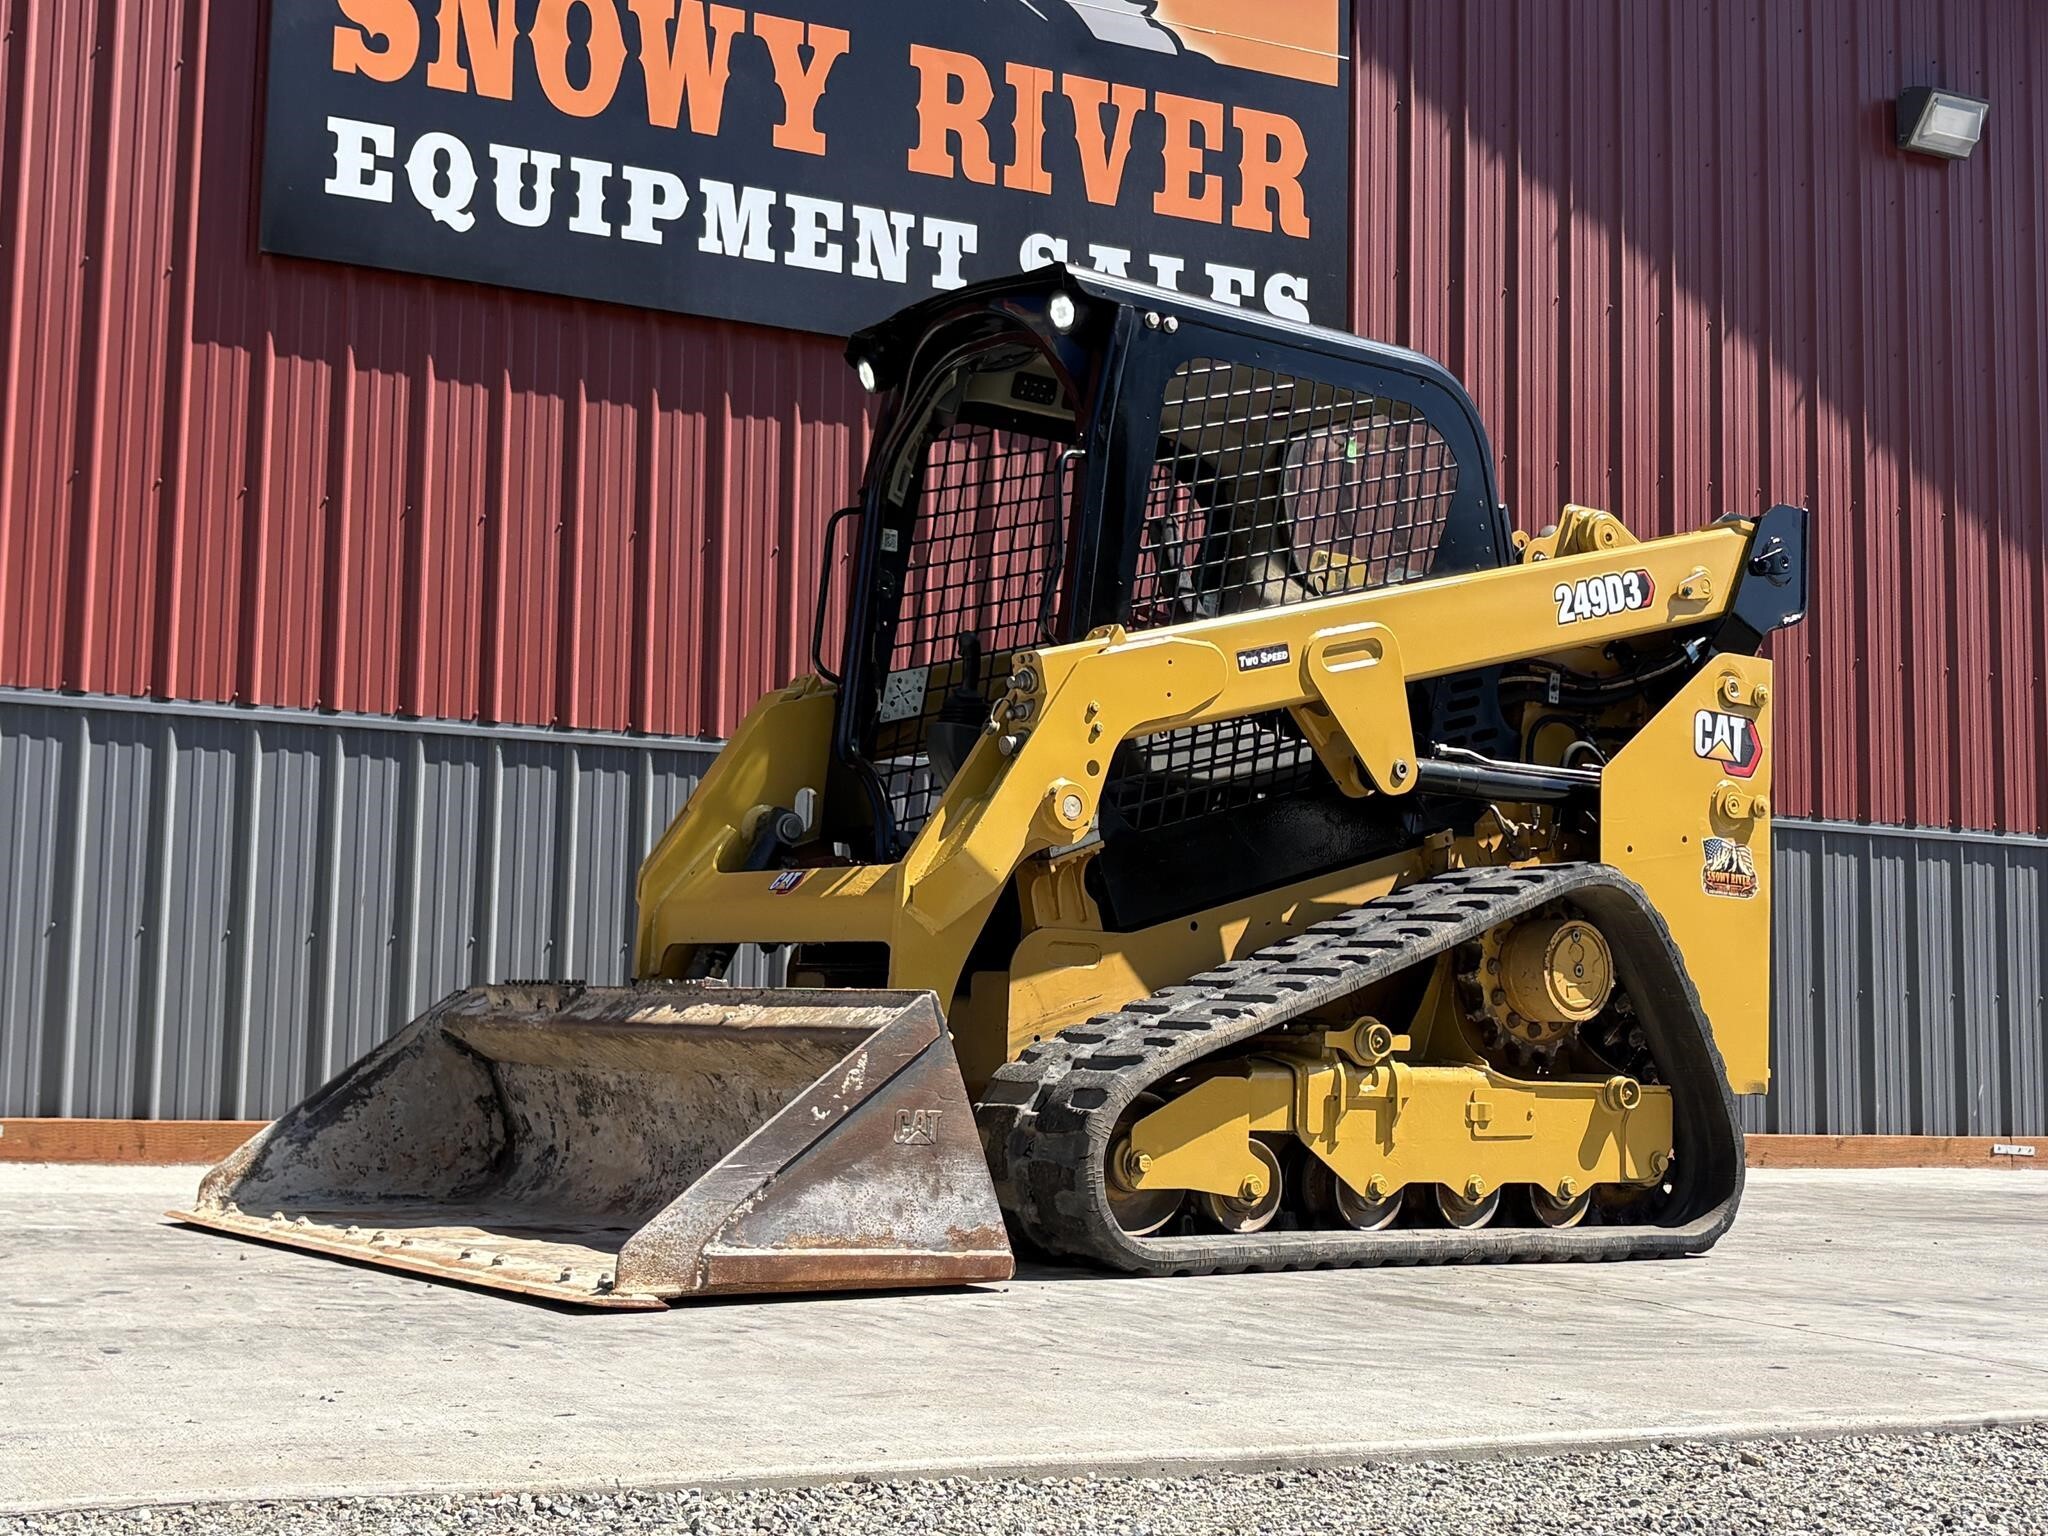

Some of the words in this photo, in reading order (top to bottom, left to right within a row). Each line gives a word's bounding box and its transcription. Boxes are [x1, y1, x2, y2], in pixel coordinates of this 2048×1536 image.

[333, 0, 849, 156] SNOWY
[908, 44, 1310, 239] RIVER
[324, 116, 978, 290] EQUIPMENT
[1554, 571, 1642, 624] 249D3
[1695, 710, 1747, 763] CAT
[769, 871, 803, 890] CAT
[894, 1109, 943, 1145] CAT
